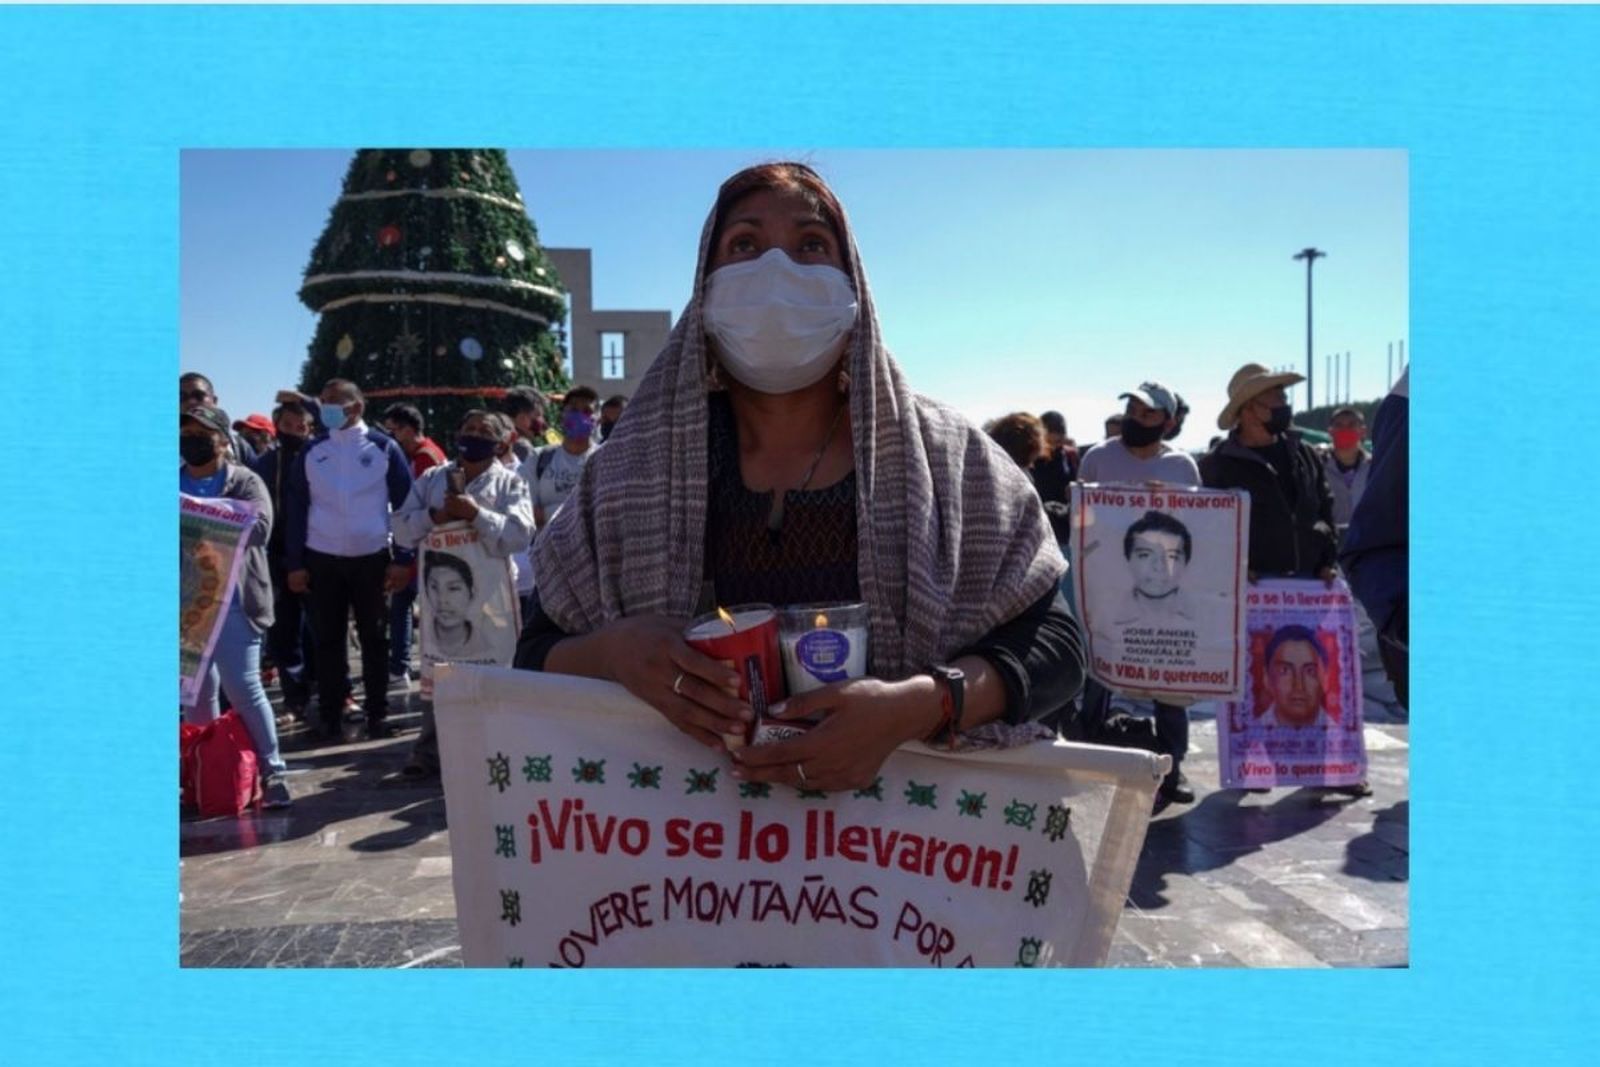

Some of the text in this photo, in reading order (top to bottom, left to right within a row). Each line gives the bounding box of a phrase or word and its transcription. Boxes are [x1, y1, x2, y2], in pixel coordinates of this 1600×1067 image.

[1129, 494, 1146, 508] se
[1150, 493, 1164, 508] lo
[1168, 493, 1235, 509] llevaron!
[1115, 663, 1145, 680] VIDA
[1149, 667, 1160, 681] lo
[1163, 670, 1228, 685] queremos!
[527, 798, 1019, 891] ¡Vivo se lo llevaron!
[549, 875, 955, 968] OVERE MONTAÑAS POR
